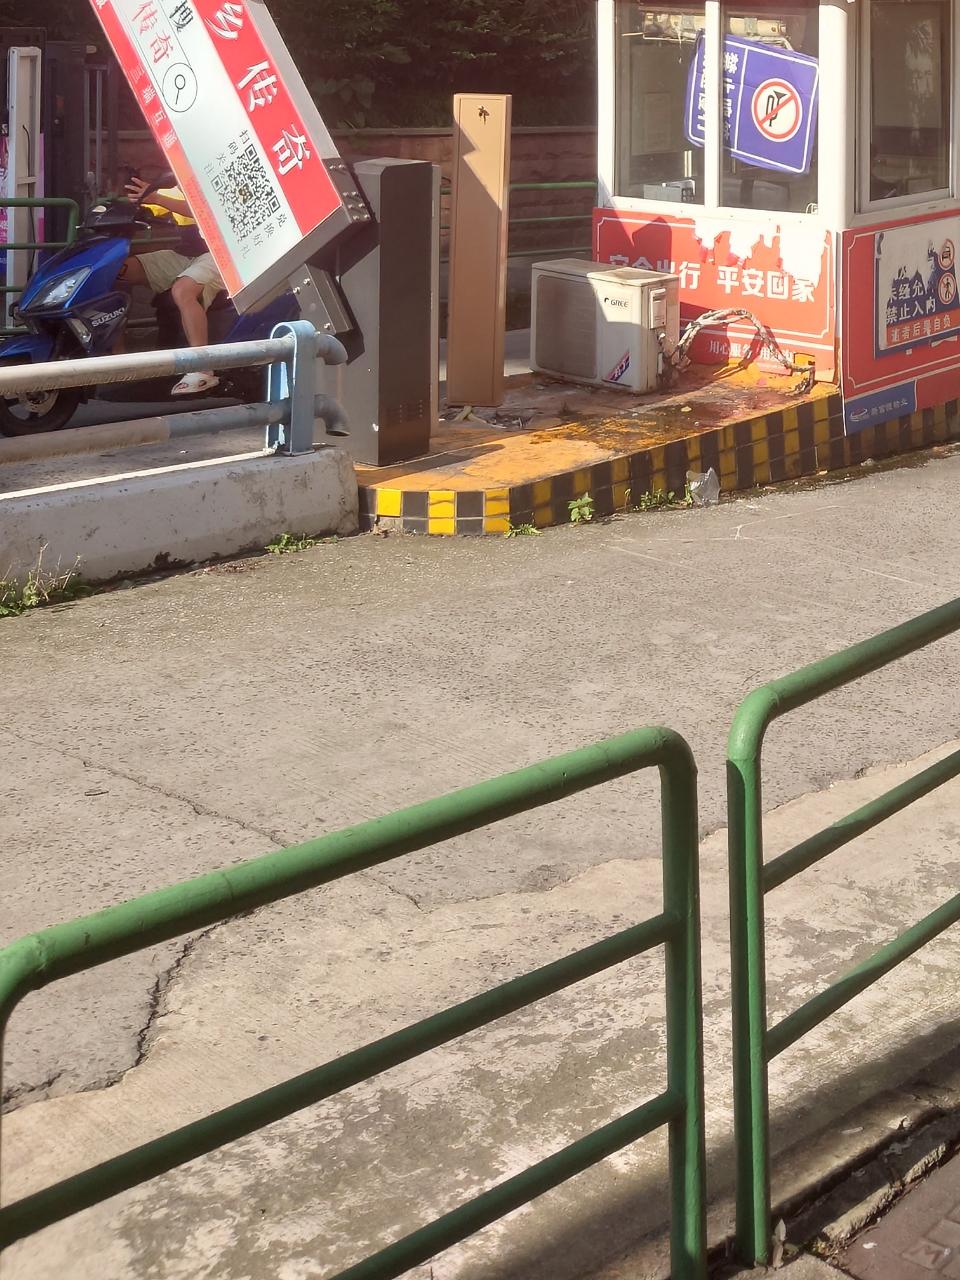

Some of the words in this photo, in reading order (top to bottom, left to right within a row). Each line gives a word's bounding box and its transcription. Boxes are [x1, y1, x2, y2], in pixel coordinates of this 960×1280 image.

[128, 62, 178, 149] 三端互通
[204, 129, 250, 178] 扫码关注
[716, 265, 815, 303] 平安回家
[91, 306, 127, 328] SUZUKI
[610, 297, 630, 308] GREE
[886, 296, 936, 324] 禁止入内
